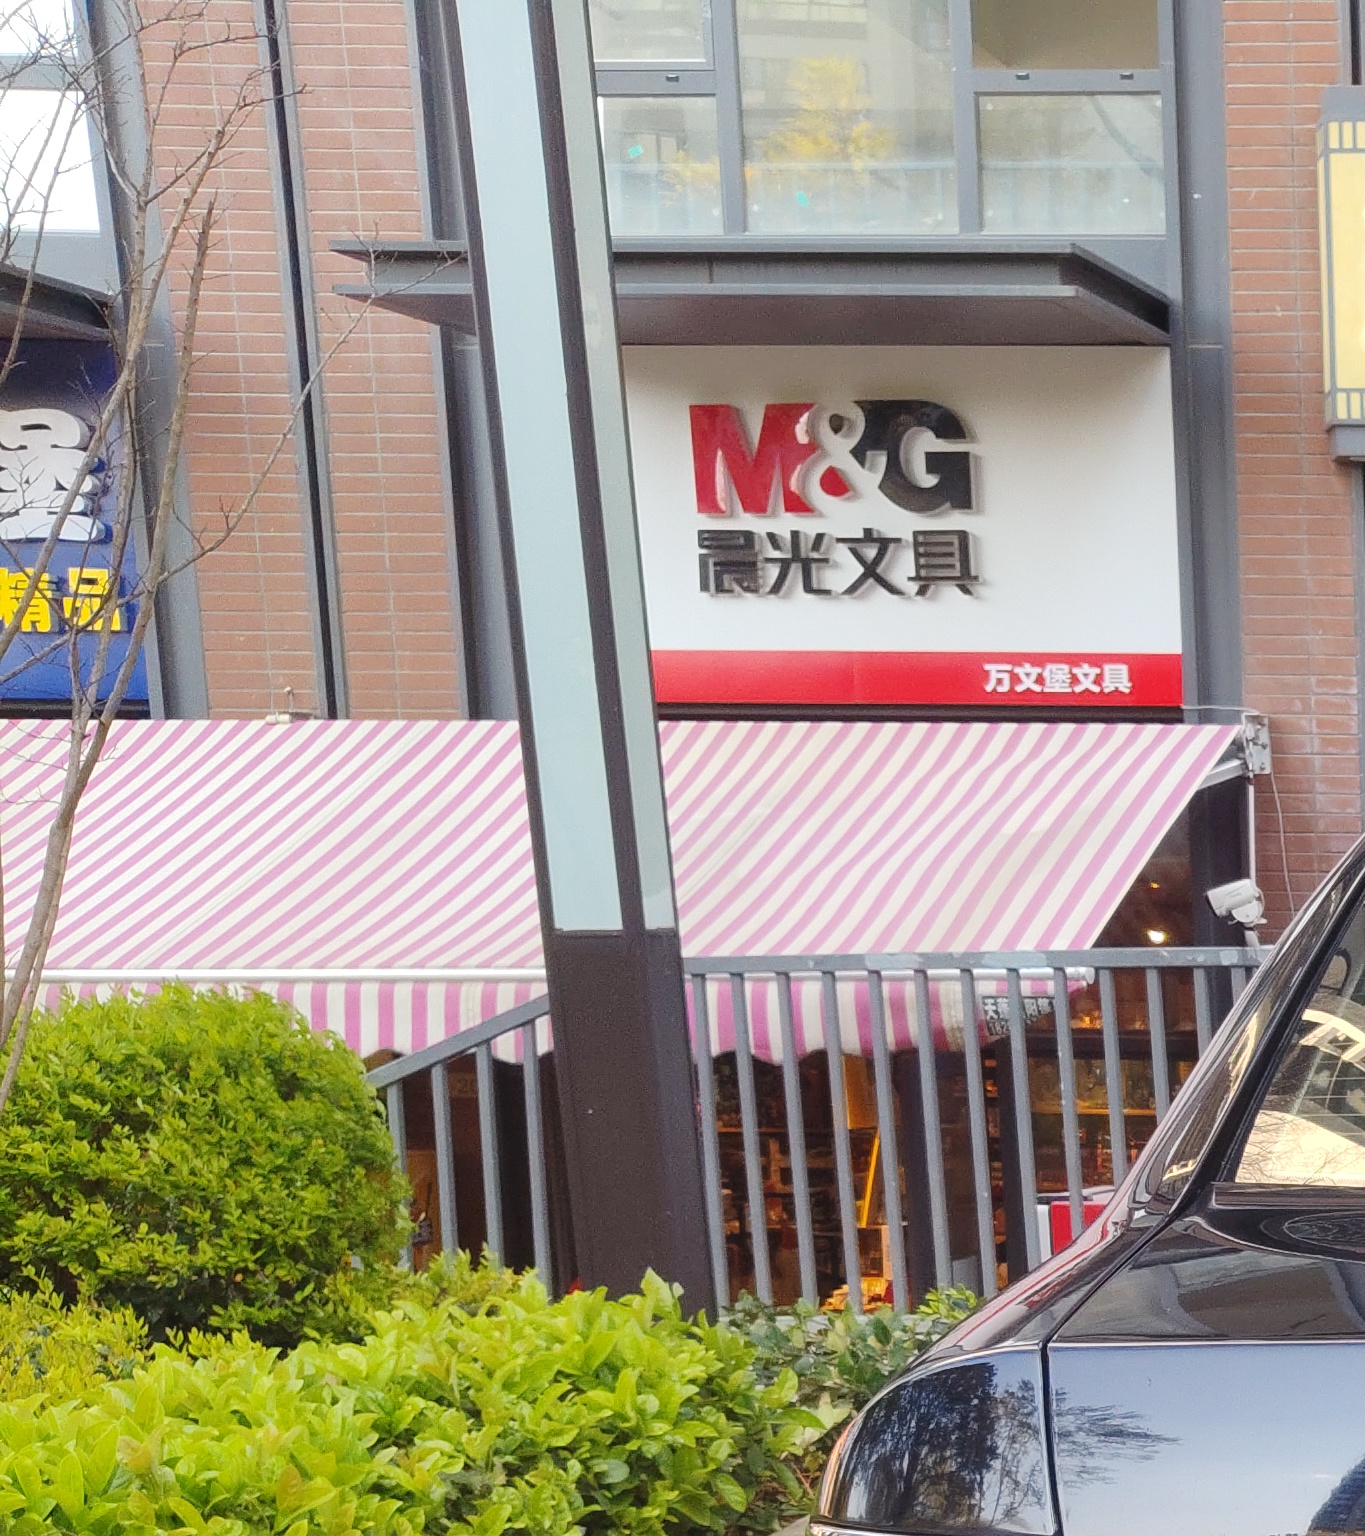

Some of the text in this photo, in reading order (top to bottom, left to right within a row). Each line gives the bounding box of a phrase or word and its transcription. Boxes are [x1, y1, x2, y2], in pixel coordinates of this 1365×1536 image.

[689, 399, 976, 515] M&G
[697, 527, 981, 597] 晨光文具
[982, 662, 1133, 695] 万文堡文具
